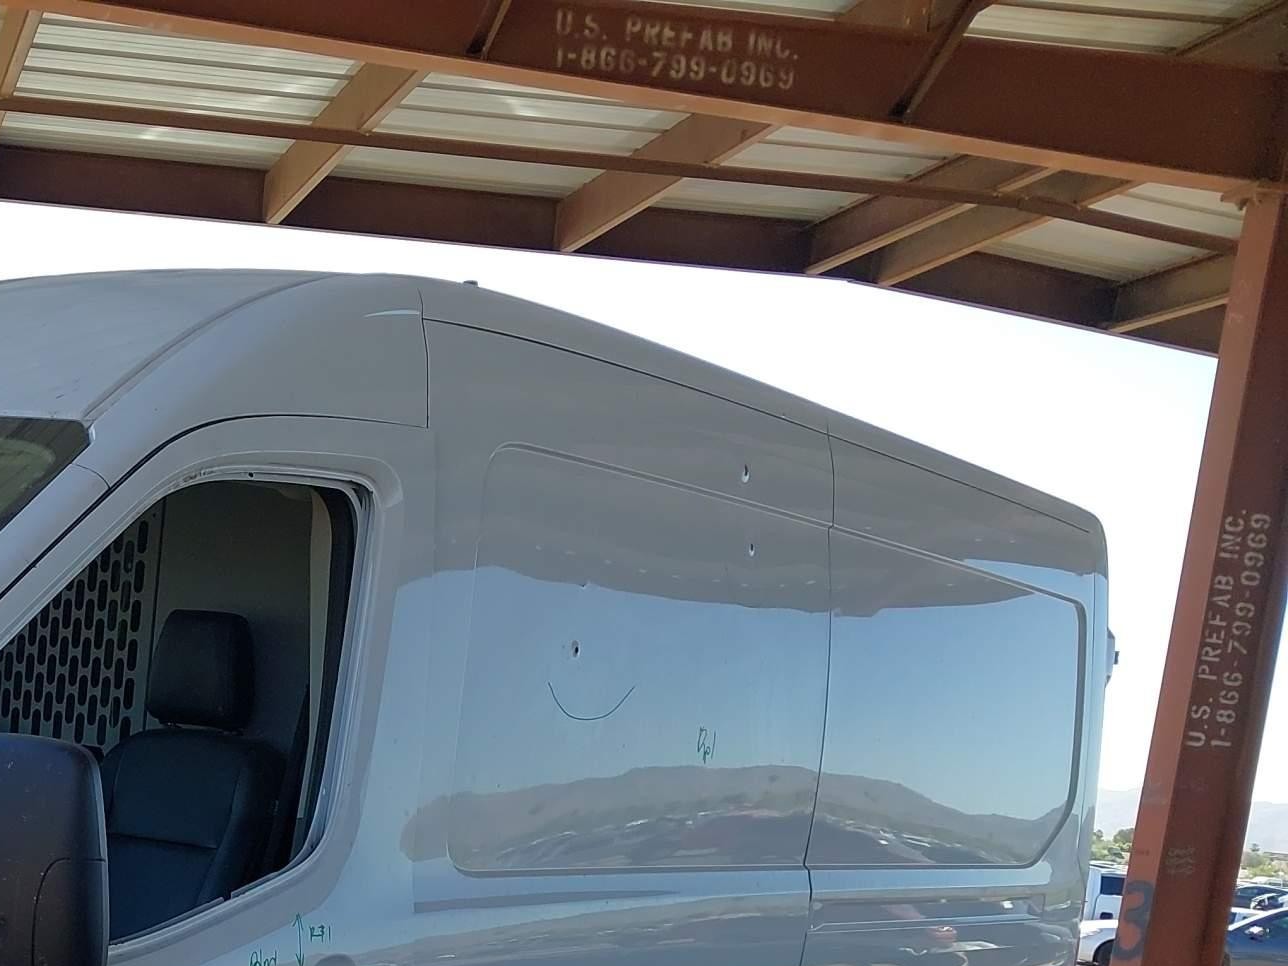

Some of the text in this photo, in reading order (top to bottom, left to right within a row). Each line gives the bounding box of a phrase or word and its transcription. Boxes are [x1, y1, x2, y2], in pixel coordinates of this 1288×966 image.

[555, 8, 608, 40] U.S.
[624, 16, 734, 51] PREFAB
[555, 46, 795, 90] 1-866-799-0969
[1186, 508, 1247, 747] U.S. PREFAB INC.
[1210, 513, 1271, 747] 1-866-799-0969
